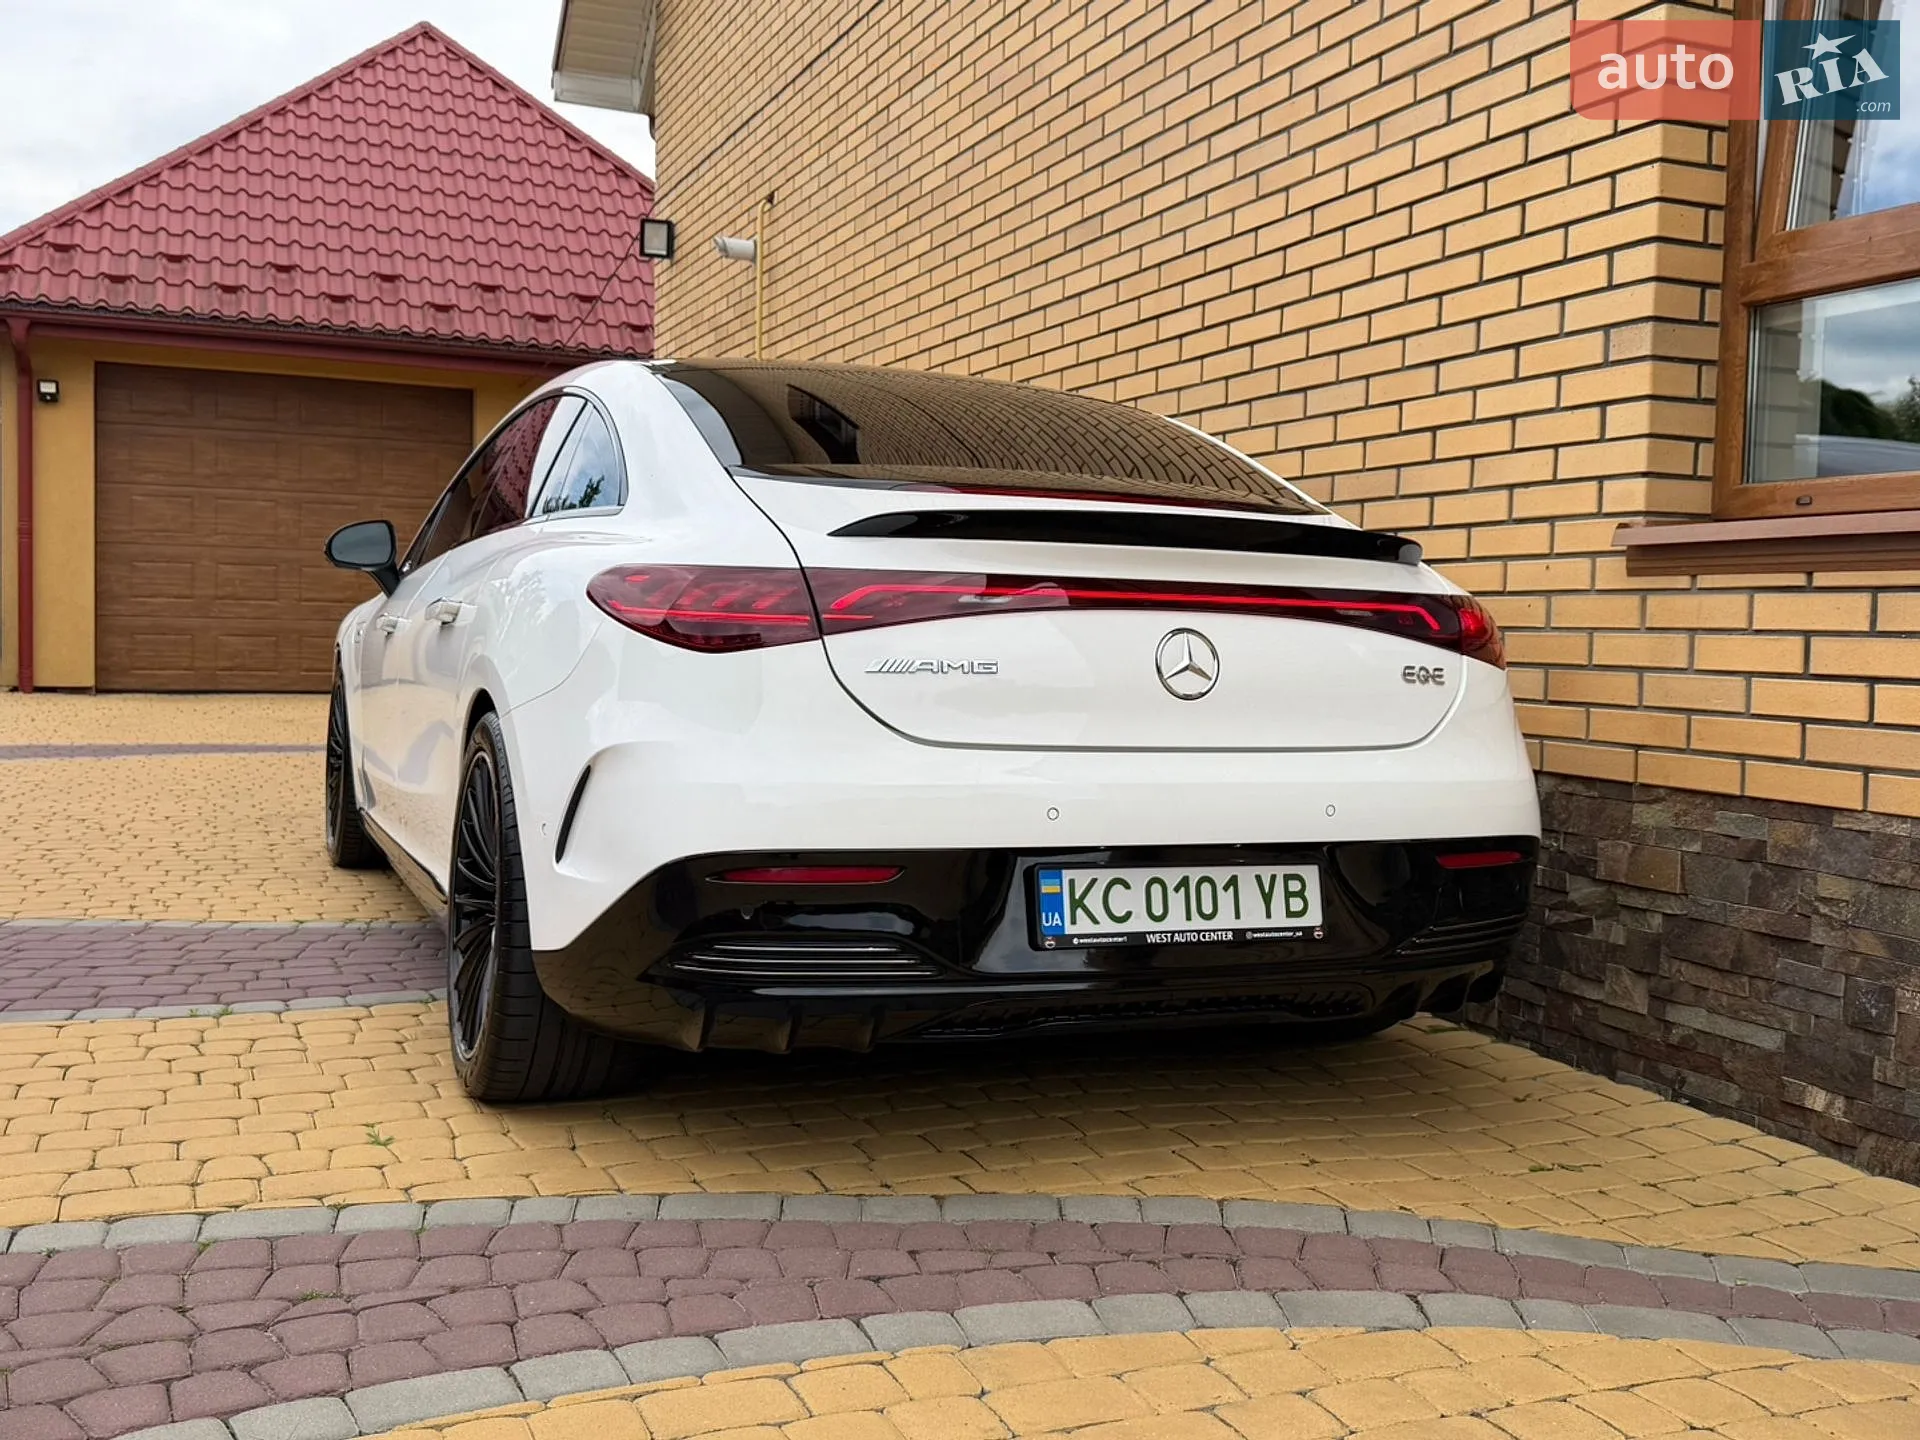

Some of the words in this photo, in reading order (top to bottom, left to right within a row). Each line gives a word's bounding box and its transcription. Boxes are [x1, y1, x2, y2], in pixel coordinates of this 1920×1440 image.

[902, 658, 999, 674] AMG
[1402, 665, 1445, 686] EQE
[1068, 876, 1133, 925] KC
[1145, 874, 1241, 923] 0101
[1255, 873, 1309, 919] YB
[1042, 912, 1062, 927] UA
[1146, 932, 1171, 943] WEST
[1173, 932, 1198, 942] AUTO
[1200, 930, 1233, 942] CENTER
